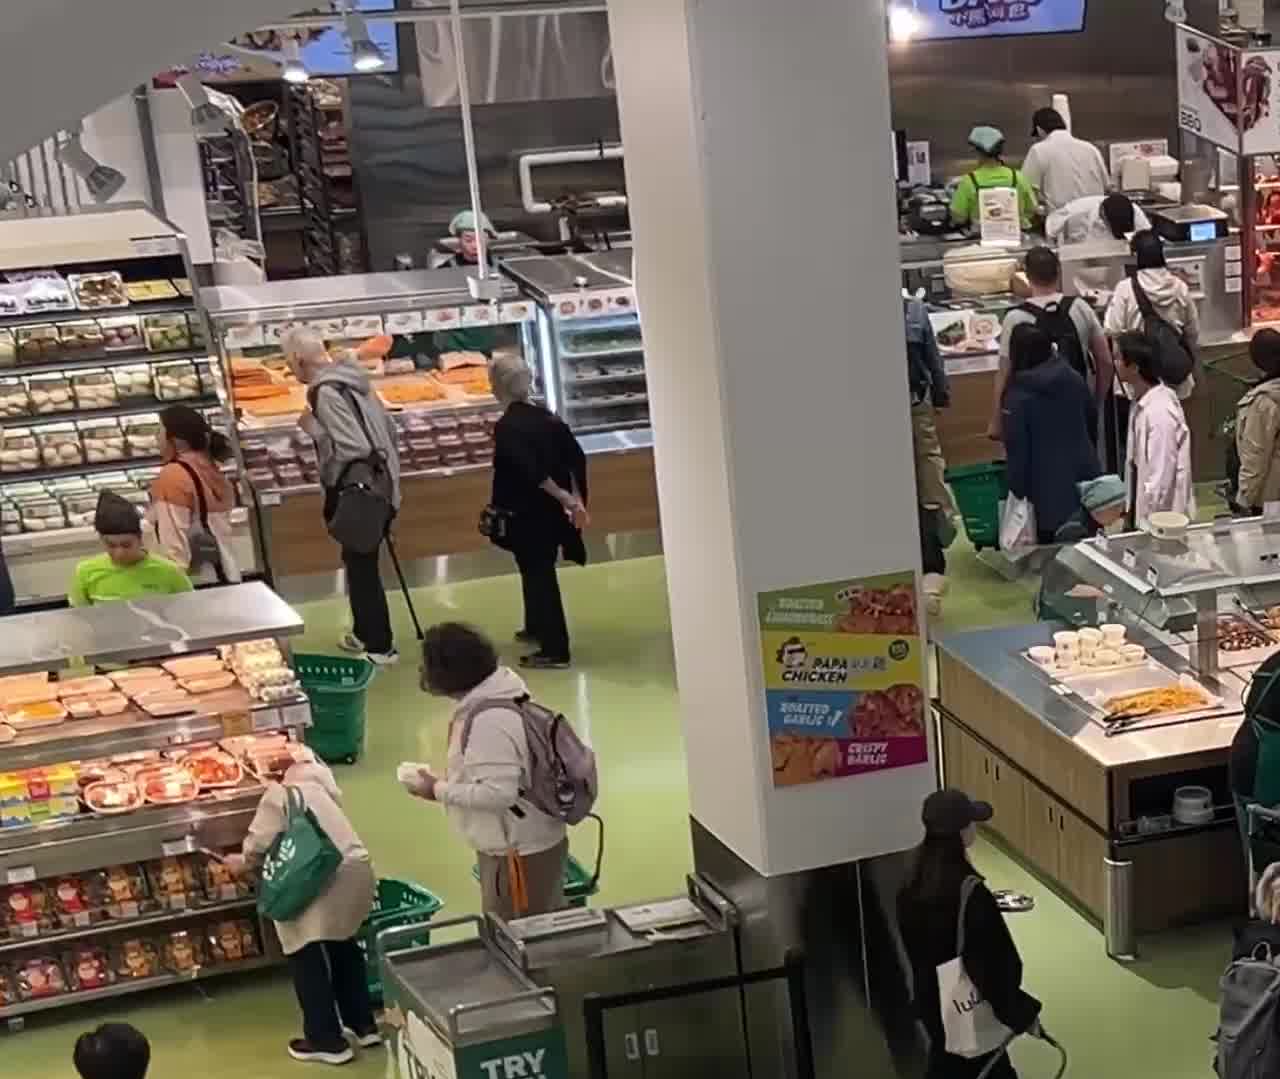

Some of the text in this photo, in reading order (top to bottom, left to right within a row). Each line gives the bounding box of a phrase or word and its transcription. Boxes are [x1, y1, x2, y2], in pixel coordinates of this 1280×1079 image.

[1180, 109, 1201, 132] BBQ
[812, 657, 848, 669] PAPA
[781, 669, 848, 682] CHICKEN
